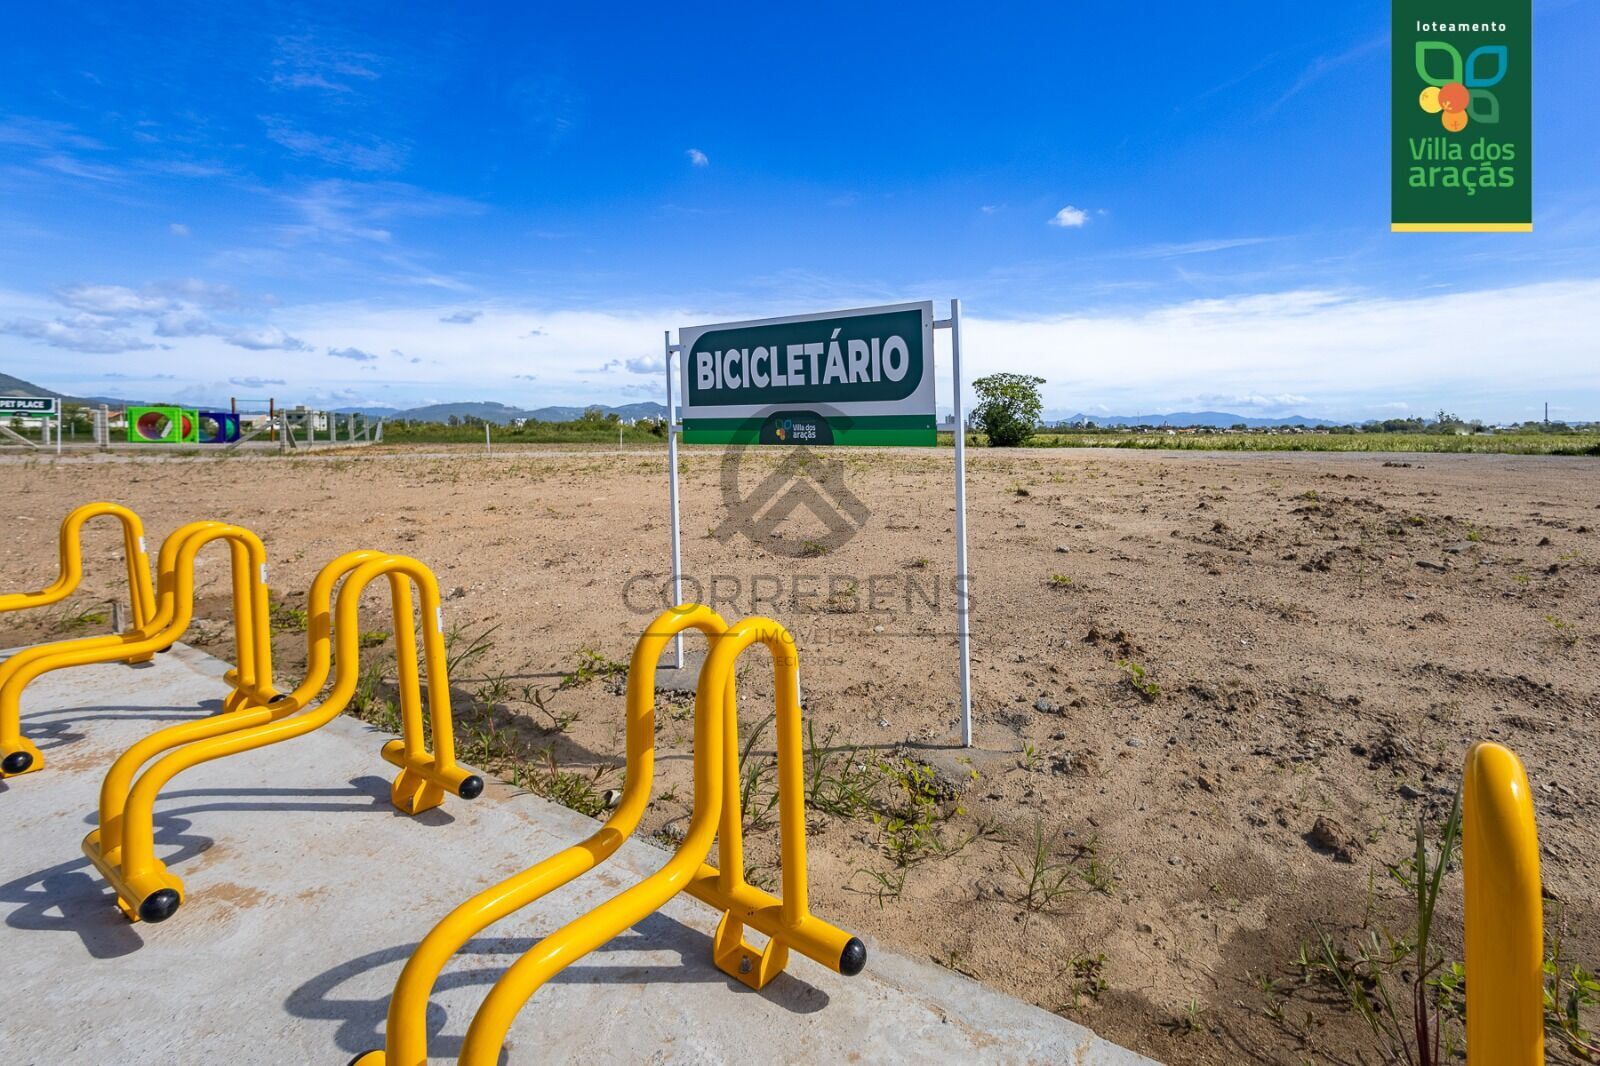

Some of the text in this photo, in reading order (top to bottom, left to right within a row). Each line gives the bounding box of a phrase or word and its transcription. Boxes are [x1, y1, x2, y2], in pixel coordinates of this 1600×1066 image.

[696, 327, 910, 391] BICICLETÁRIO
[17, 400, 45, 408] PLACE
[793, 423, 816, 431] Villa dos
